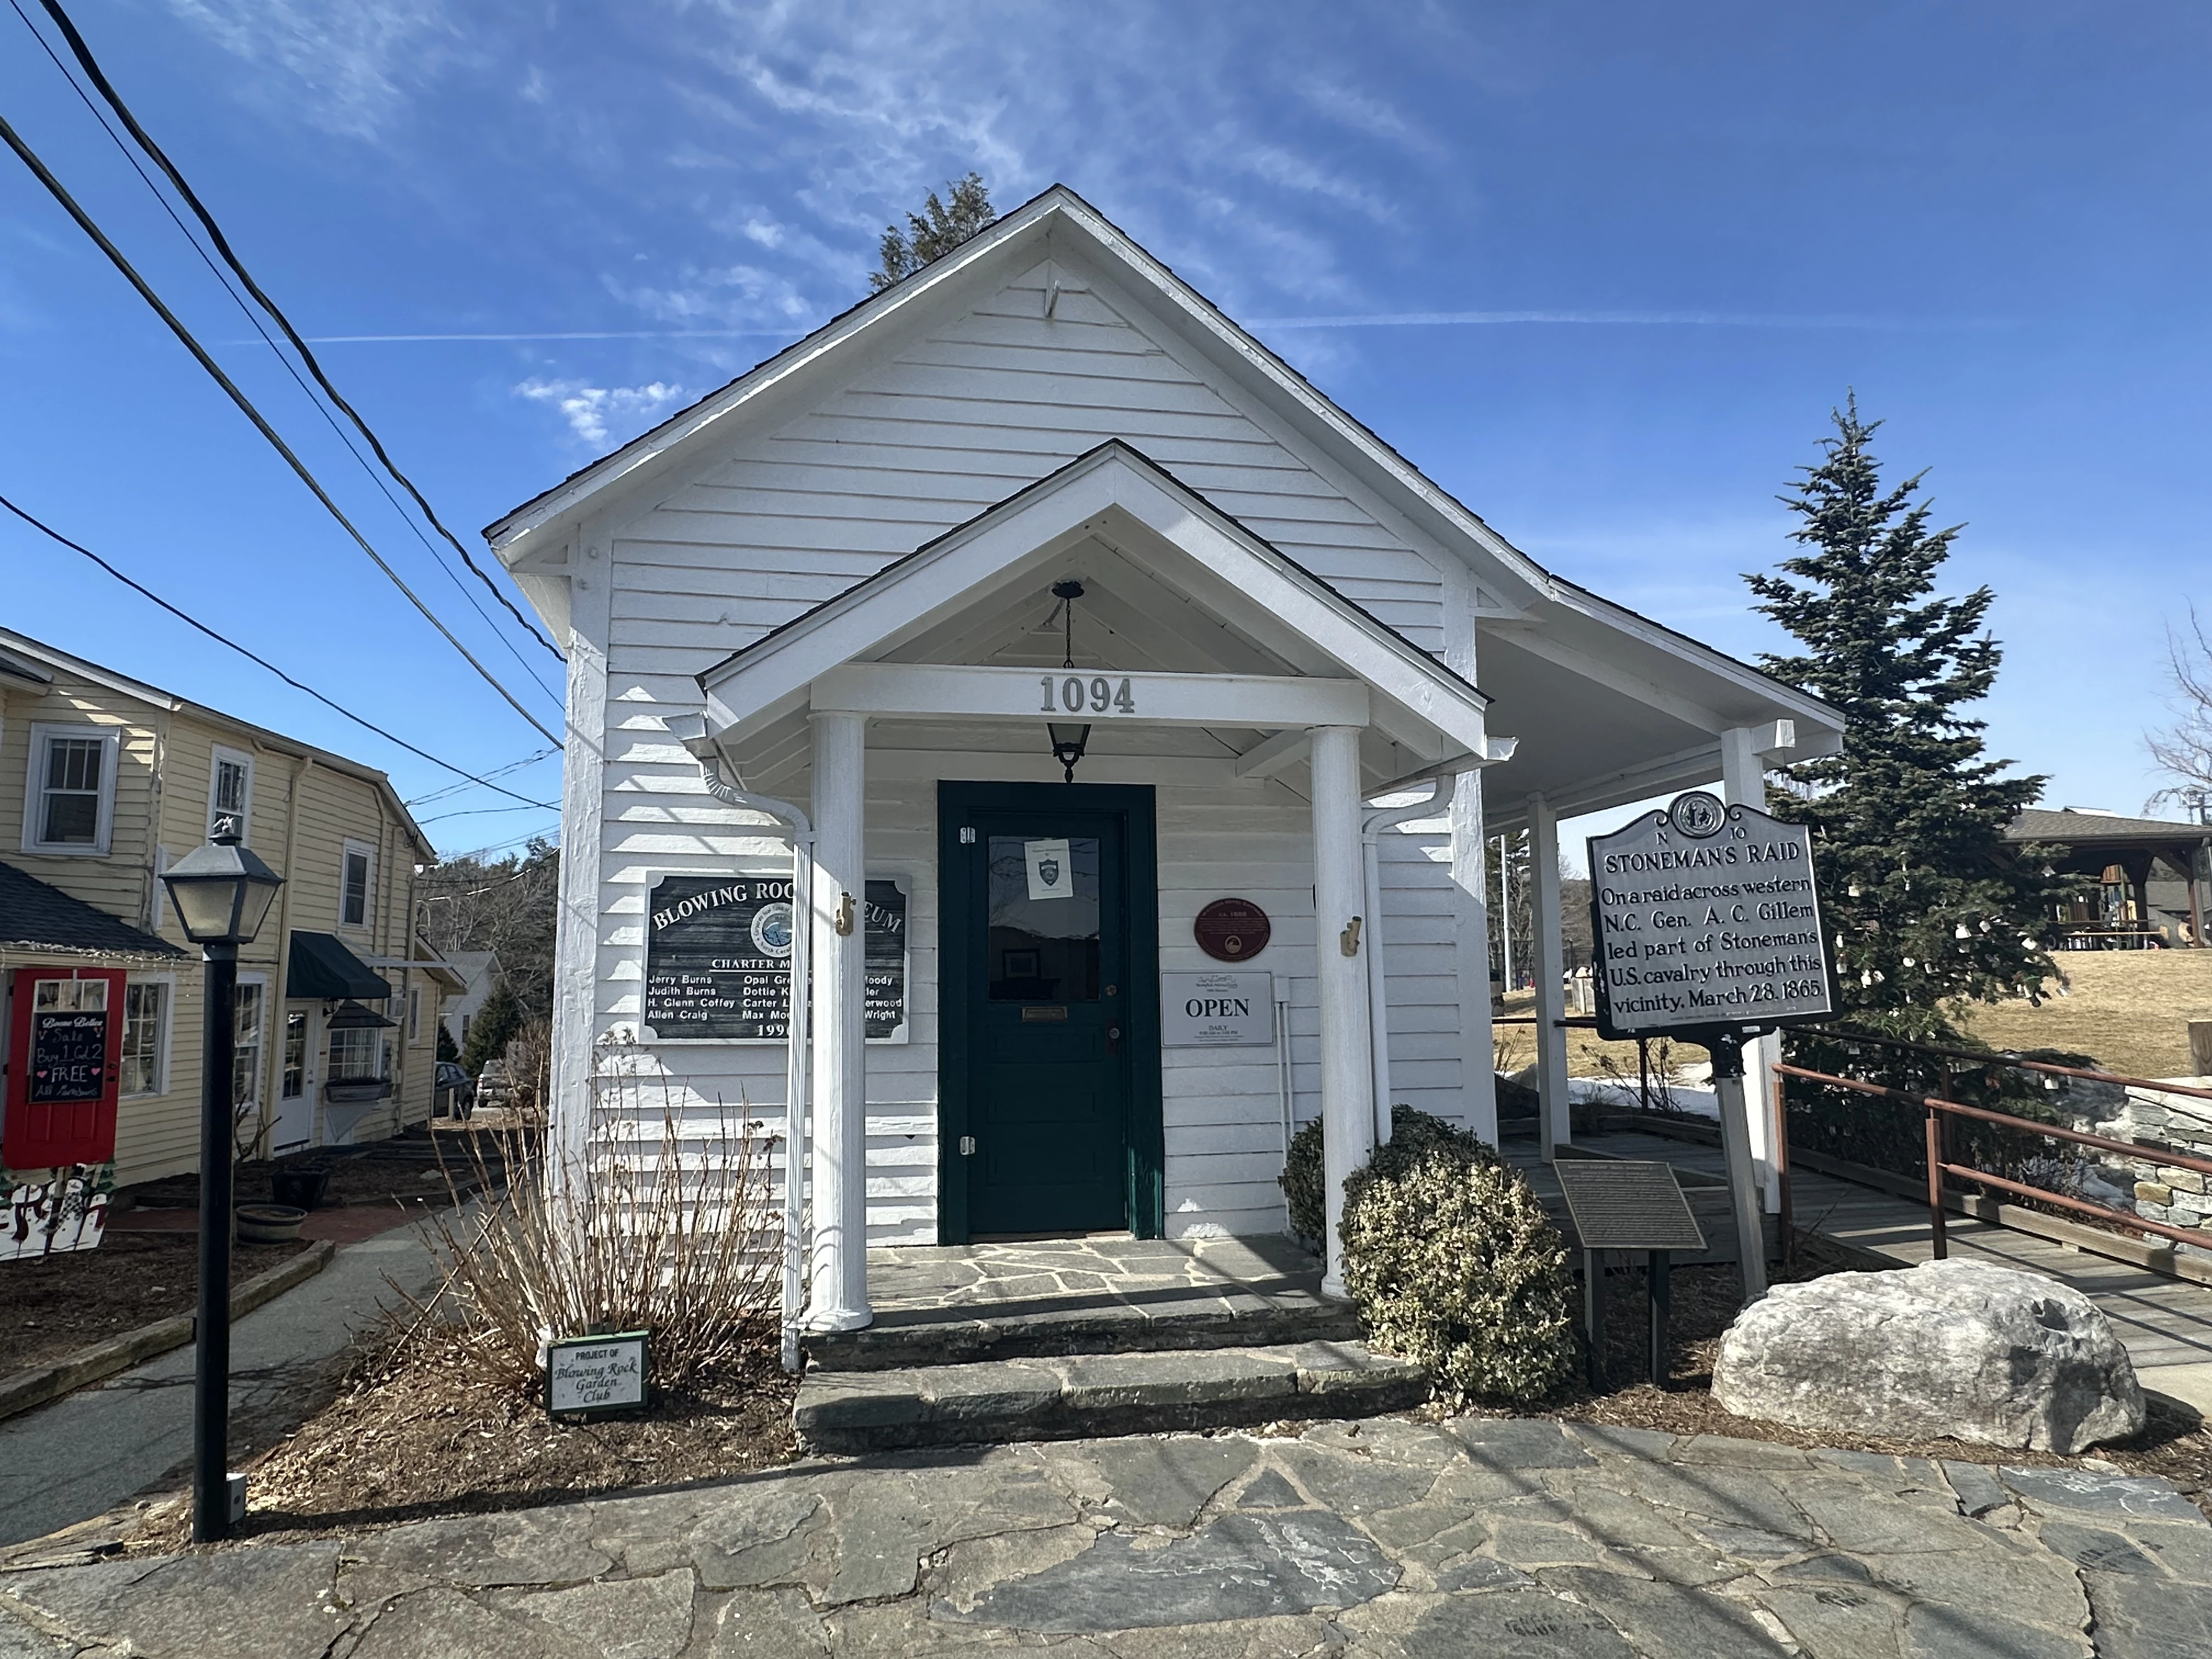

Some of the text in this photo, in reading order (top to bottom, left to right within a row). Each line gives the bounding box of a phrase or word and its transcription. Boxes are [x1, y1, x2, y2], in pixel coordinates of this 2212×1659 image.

[1040, 676, 1135, 713] 1094
[1655, 832, 1667, 844] N
[1745, 842, 1799, 862] RAID
[1601, 874, 1810, 905] On a raid across western
[652, 884, 747, 930] BLOWING
[756, 882, 793, 899] ROC
[1604, 900, 1814, 933] N.C. Gen. A. C. Gillem
[1607, 940, 1638, 960] led
[1644, 936, 1686, 961] part
[1693, 933, 1713, 952] of
[712, 960, 775, 969] CHARTER
[1609, 954, 1821, 986] U.S. cavalry through this
[648, 975, 712, 985] Jerry Burns
[744, 975, 768, 985] Opal
[648, 987, 716, 996] Judith Burns
[743, 987, 776, 996] Dottie
[1688, 986, 1747, 1007] March
[1782, 979, 1824, 1000] 1865.
[647, 998, 736, 1008] H. Glenn Coffey
[743, 998, 777, 1007] Carter
[1185, 998, 1250, 1018] OPEN
[647, 1011, 708, 1021] Allen Craig
[742, 1011, 764, 1019] Max
[865, 1010, 896, 1020] Wright
[53, 1028, 83, 1042] Sale
[757, 1024, 789, 1036] 199
[37, 1048, 59, 1068] Buy
[91, 1043, 103, 1059] 2
[51, 1065, 89, 1083] FREE
[575, 1348, 619, 1361] PROJECT OF
[554, 1357, 639, 1380] Blowing Rock
[576, 1375, 617, 1394] Garden
[583, 1387, 611, 1403] Club
